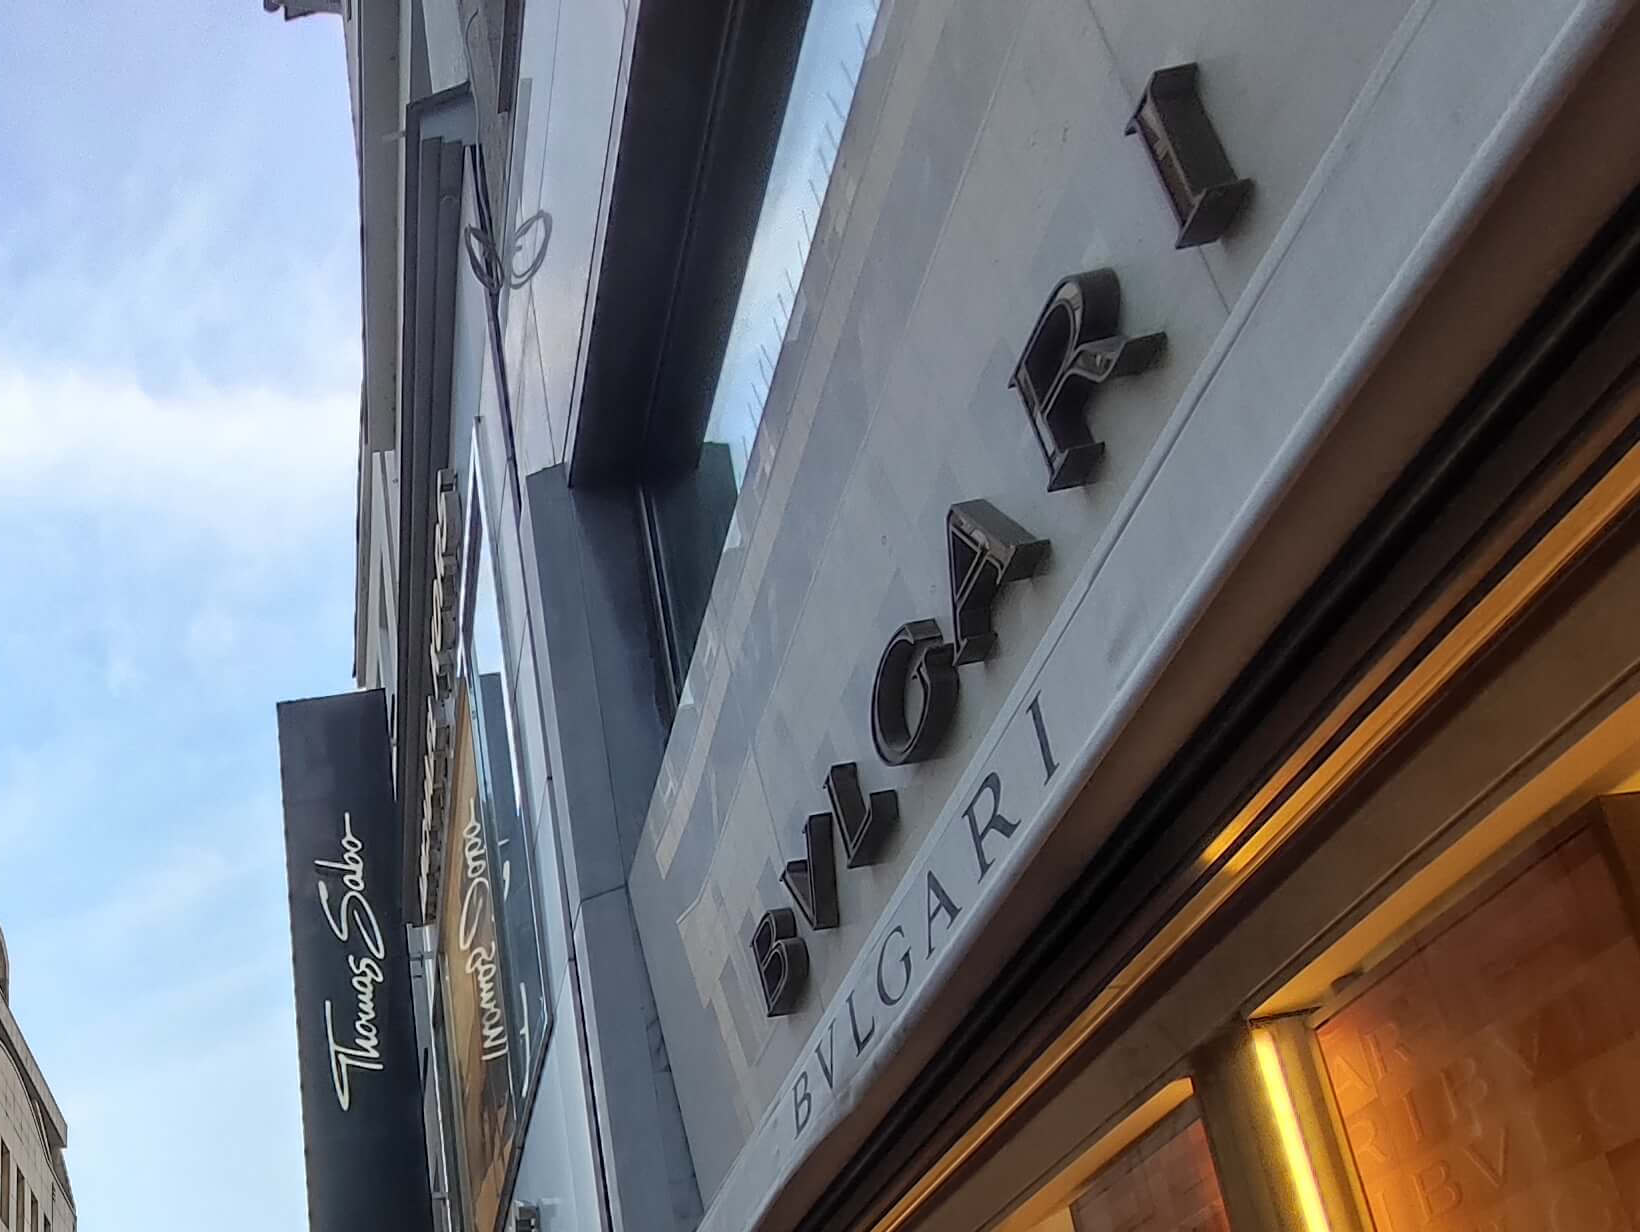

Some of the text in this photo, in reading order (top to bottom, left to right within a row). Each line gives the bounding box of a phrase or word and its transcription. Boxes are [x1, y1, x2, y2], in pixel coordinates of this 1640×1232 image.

[750, 62, 1256, 1018] BVLGARI
[313, 812, 386, 1112] Thomas Sabo
[792, 689, 1060, 1140] BVLGARI
